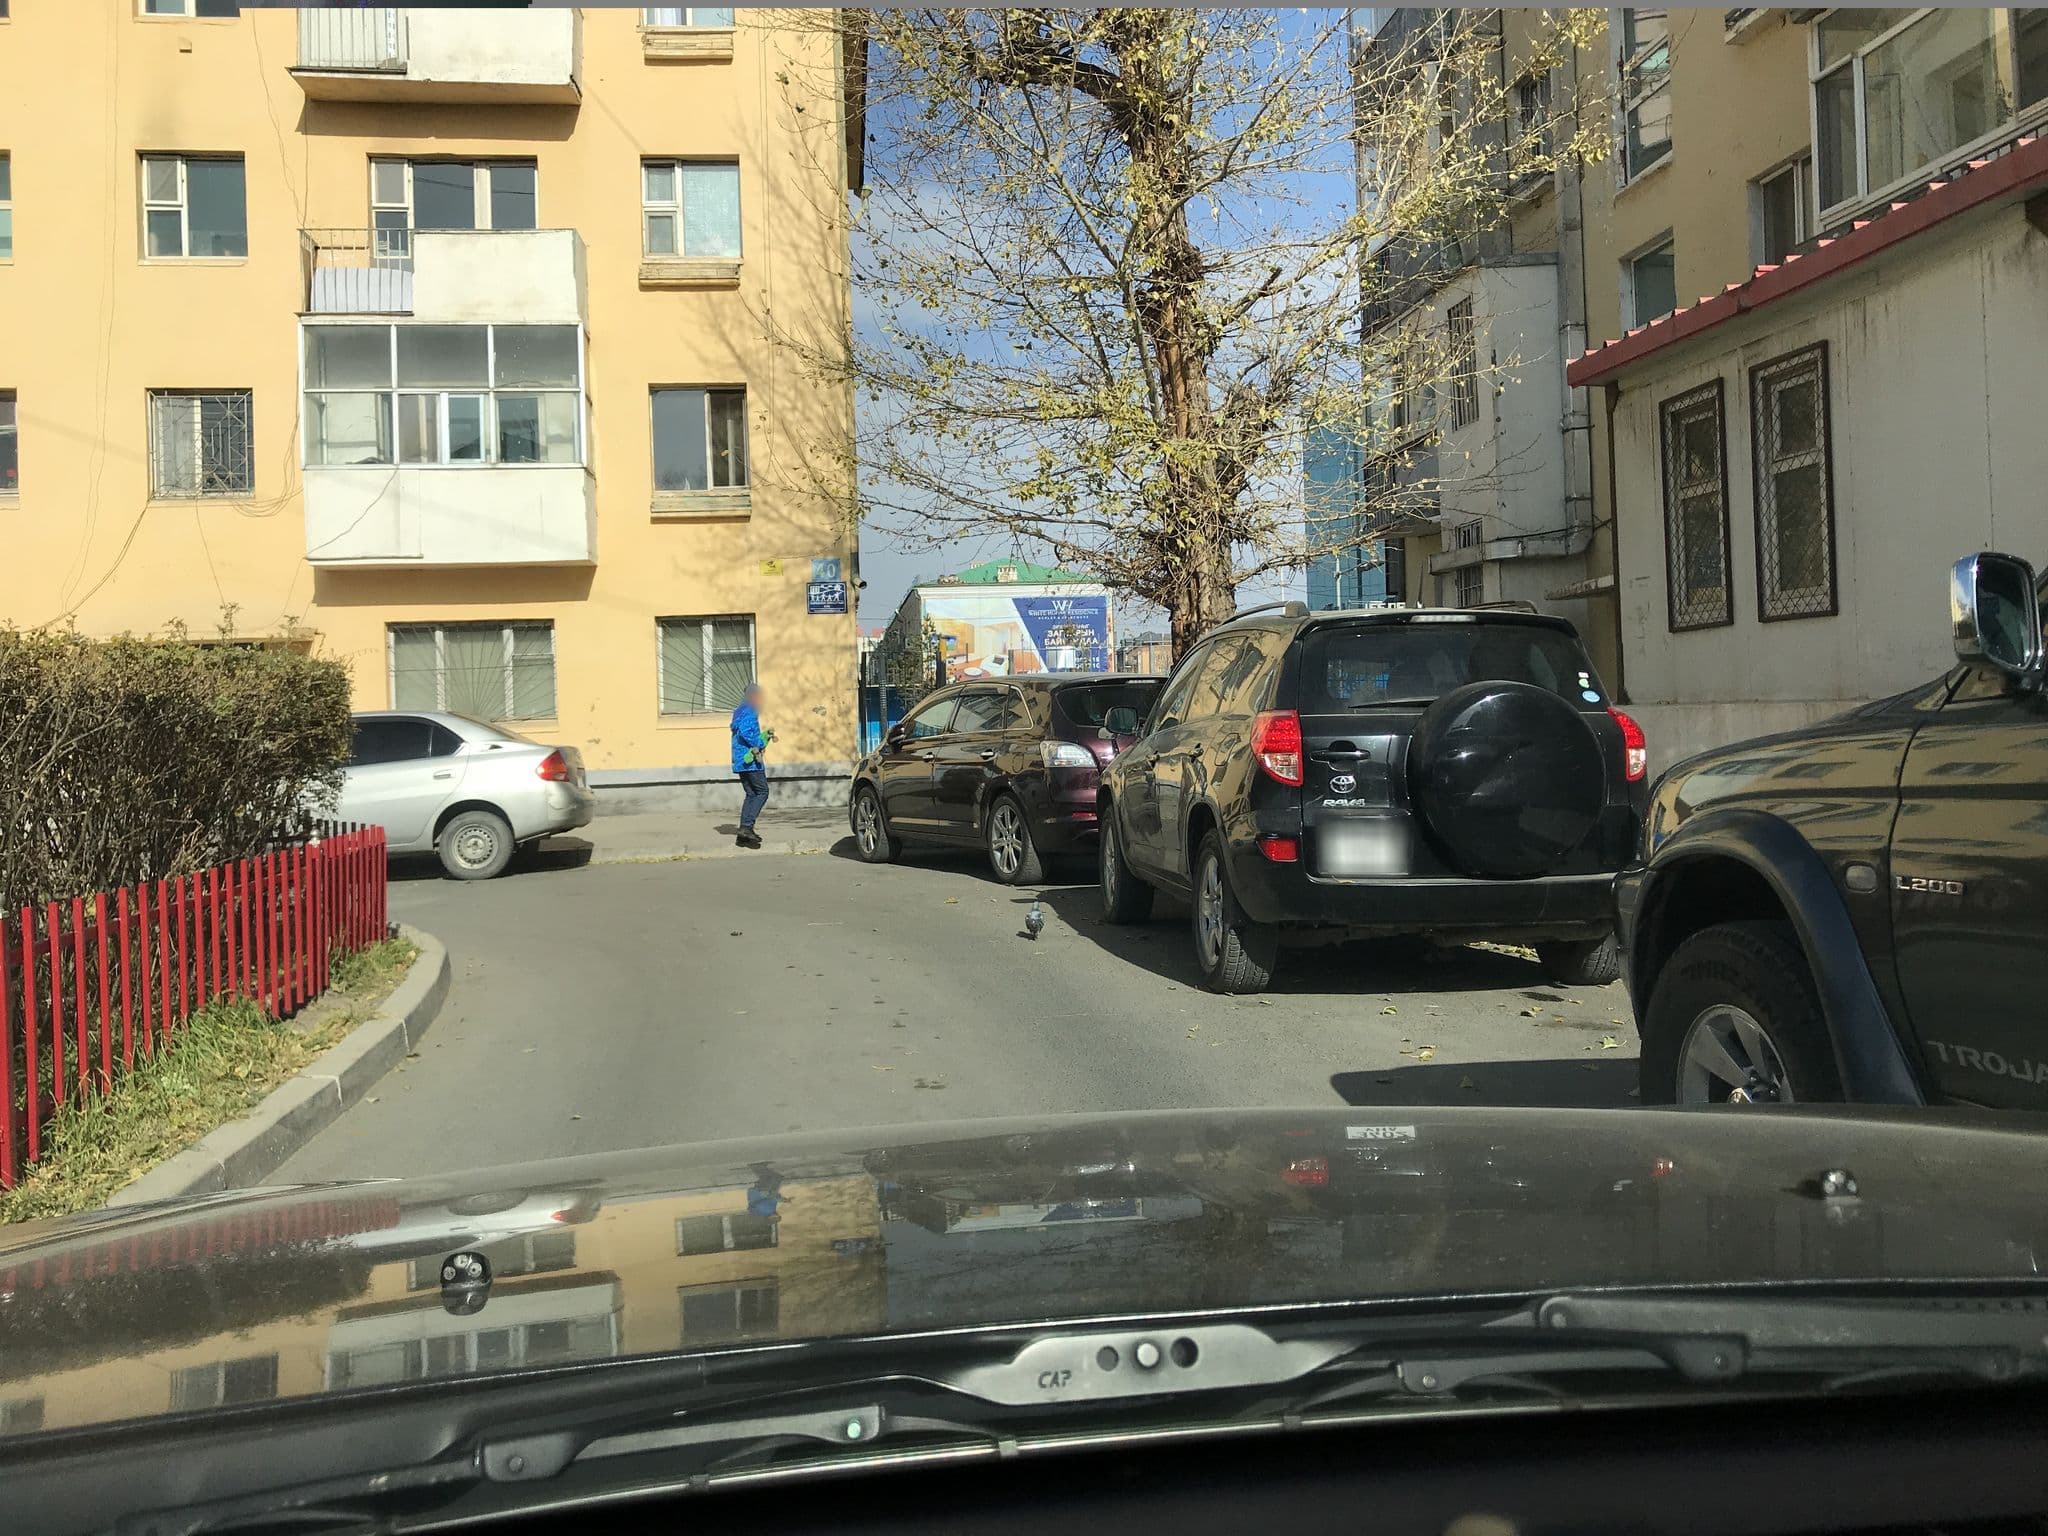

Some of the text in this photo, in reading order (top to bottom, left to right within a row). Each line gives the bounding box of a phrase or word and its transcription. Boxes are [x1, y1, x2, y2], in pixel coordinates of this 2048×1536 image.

[816, 563, 836, 577] 40
[1047, 629, 1094, 637] ЗАГРЫН
[1322, 798, 1366, 807] RAV4
[1896, 876, 1964, 896] L200
